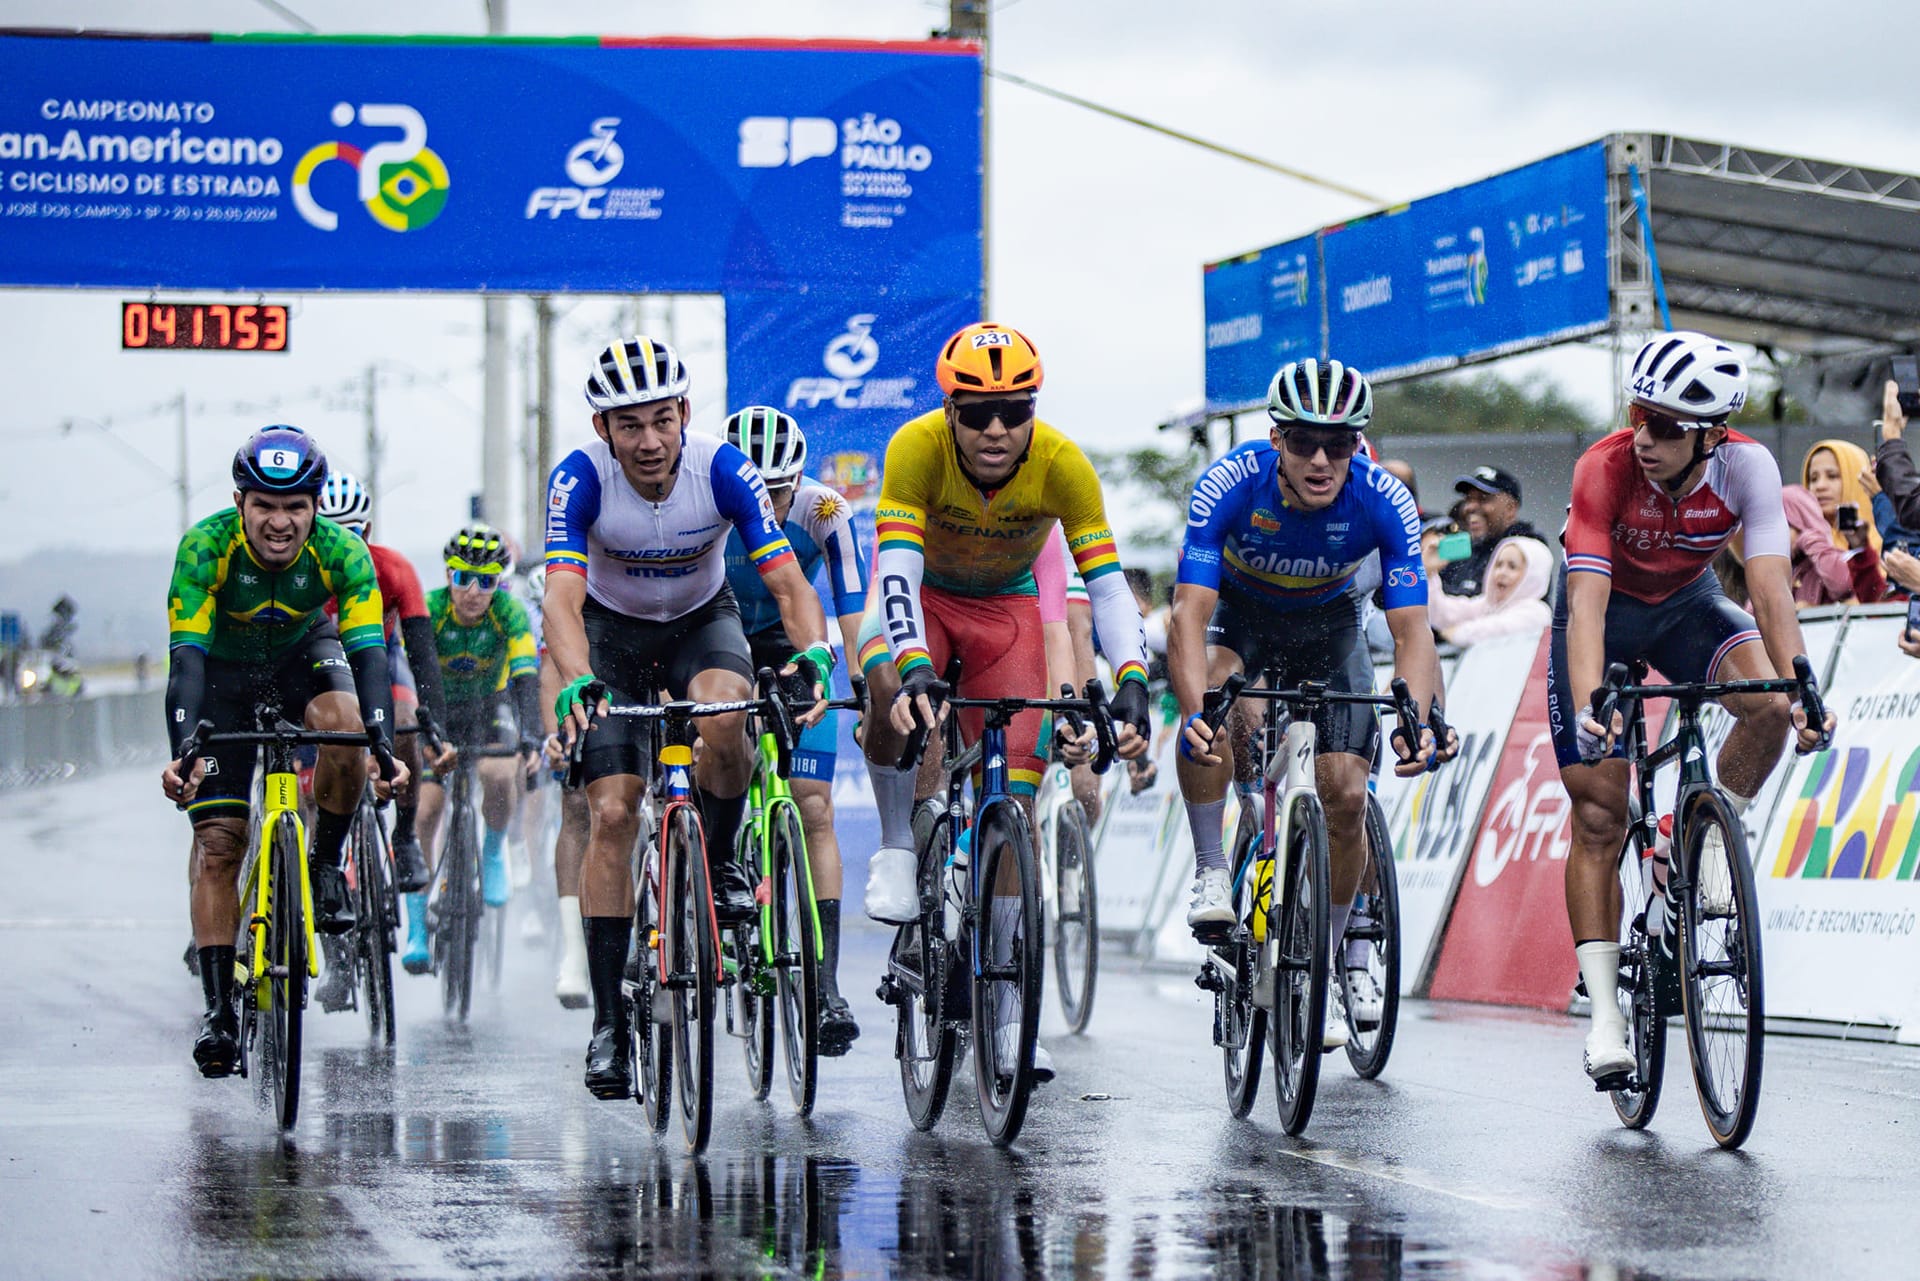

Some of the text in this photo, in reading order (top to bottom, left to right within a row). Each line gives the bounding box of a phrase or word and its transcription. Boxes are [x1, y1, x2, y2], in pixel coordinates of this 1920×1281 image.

[41, 98, 215, 123] CAMPEONATO
[842, 113, 902, 145] SÃO
[842, 145, 932, 171] PAULO
[10, 171, 129, 192] CICLISMO
[135, 174, 165, 195] DE
[171, 176, 281, 197] ESTRADA
[526, 187, 607, 219] FPC
[975, 333, 1011, 347] 231
[785, 377, 865, 409] FPC
[1632, 376, 1656, 397] 44
[273, 451, 284, 466] 6
[1187, 449, 1260, 528] Colombia
[1366, 463, 1422, 557] Colombia
[1684, 507, 1719, 519] Santini
[927, 513, 1039, 539] GRENADA
[1616, 523, 1672, 540] COSTA
[604, 540, 714, 559] VENEZUELA
[1238, 547, 1357, 578] Colombia
[1548, 693, 1564, 736] RICA
[279, 776, 287, 806] BMC
[1768, 903, 1806, 932] UNIÃO
[1818, 907, 1916, 941] RECONSTRUÇÃO
